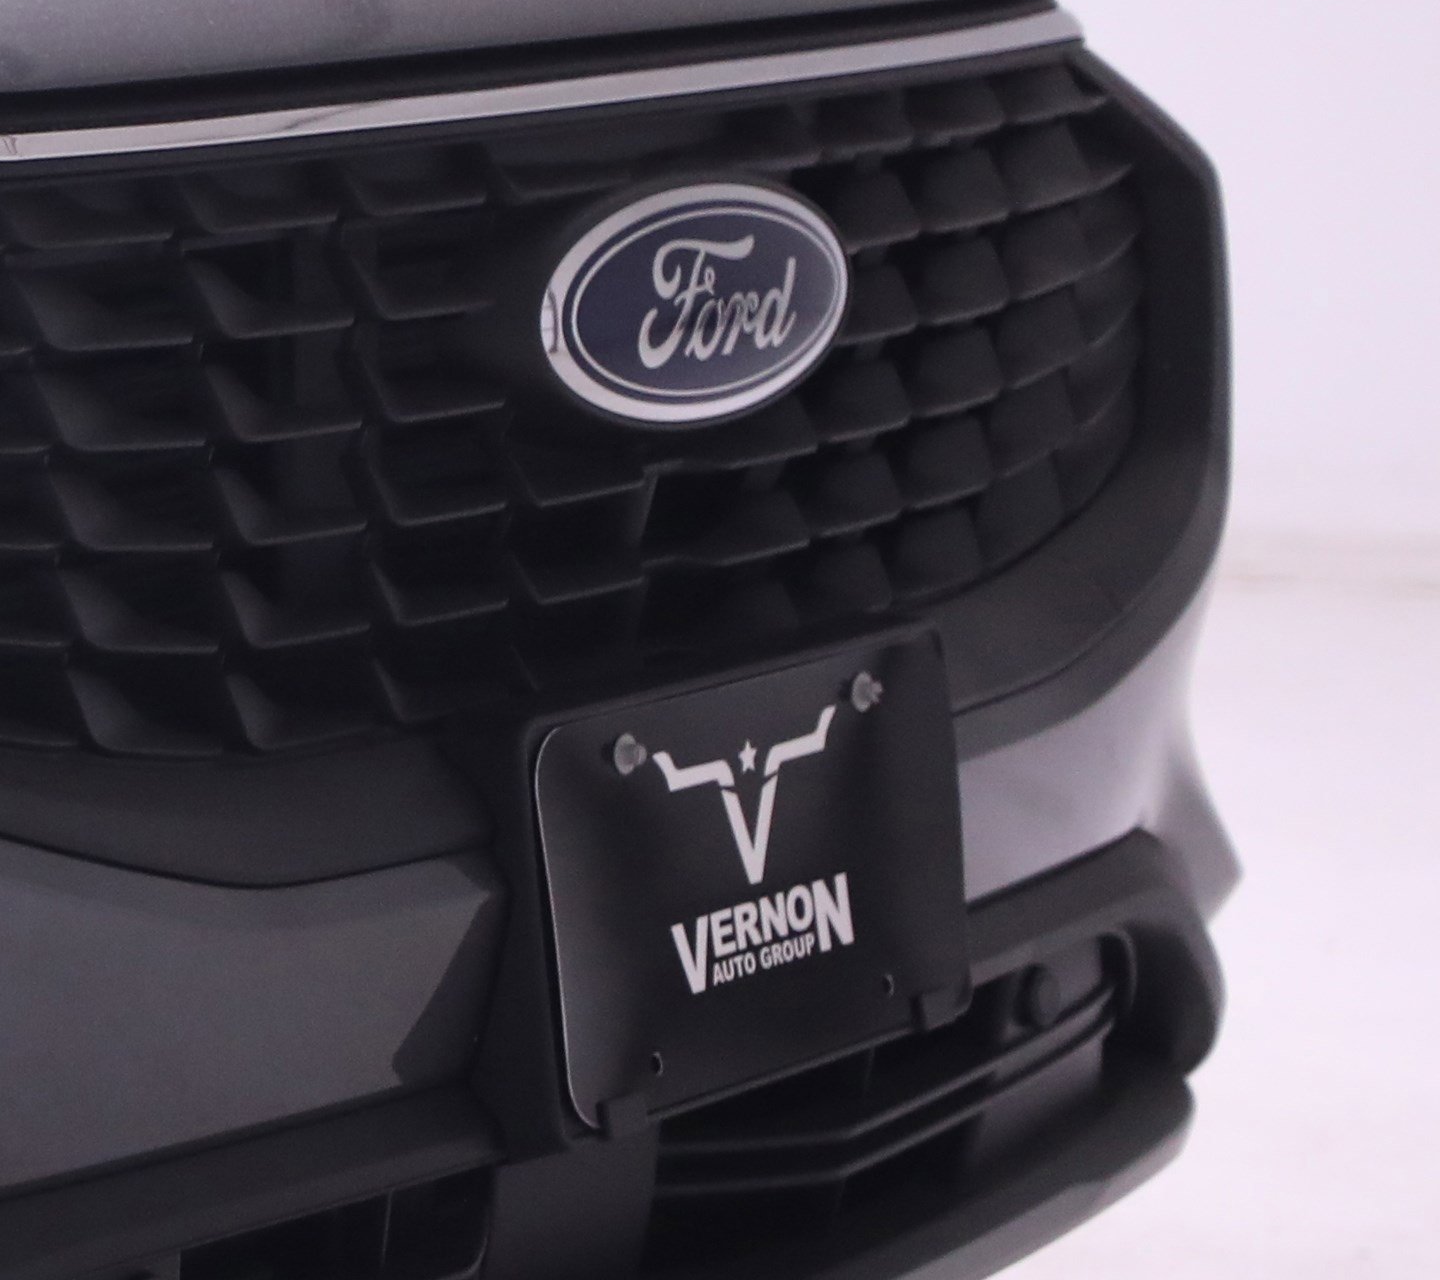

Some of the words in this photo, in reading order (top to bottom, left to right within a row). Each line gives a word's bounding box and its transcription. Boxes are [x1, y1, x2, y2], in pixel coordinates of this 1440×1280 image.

[638, 234, 797, 369] Ford
[671, 872, 855, 994] VERNON
[713, 952, 756, 986] AUTO
[760, 933, 815, 969] GROUP
